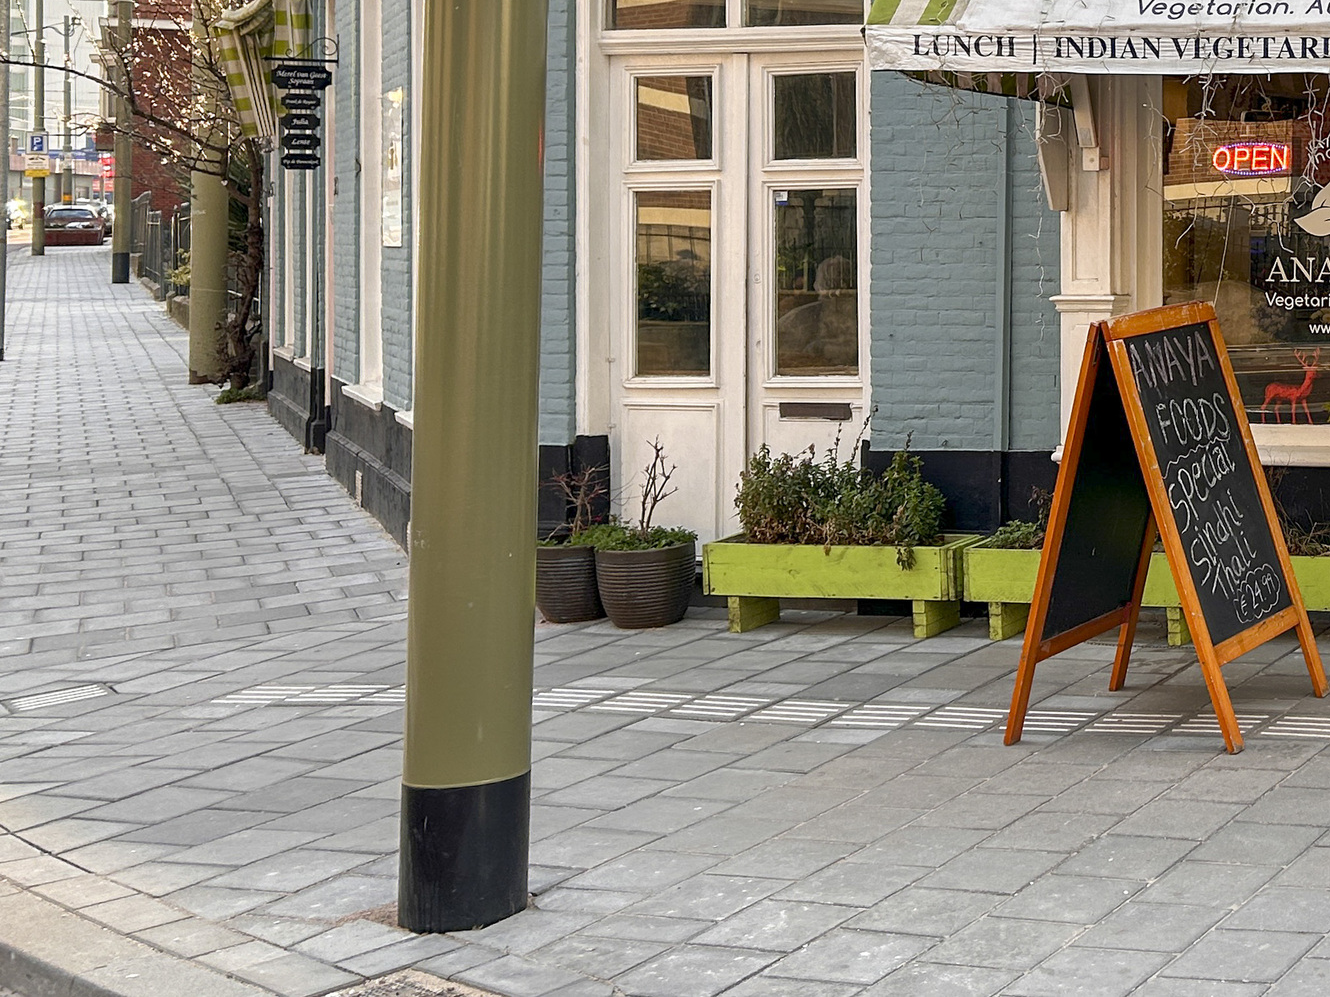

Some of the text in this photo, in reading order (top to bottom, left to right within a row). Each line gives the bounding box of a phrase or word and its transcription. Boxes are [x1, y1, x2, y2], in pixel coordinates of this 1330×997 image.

[912, 34, 1015, 57] LUNCH
[1054, 35, 1162, 59] INDIAN
[33, 137, 42, 146] P
[1213, 145, 1289, 171] OPEN
[1129, 331, 1215, 393] ANAYA
[1155, 393, 1230, 445] FOODS
[1211, 531, 1257, 600] Thali
